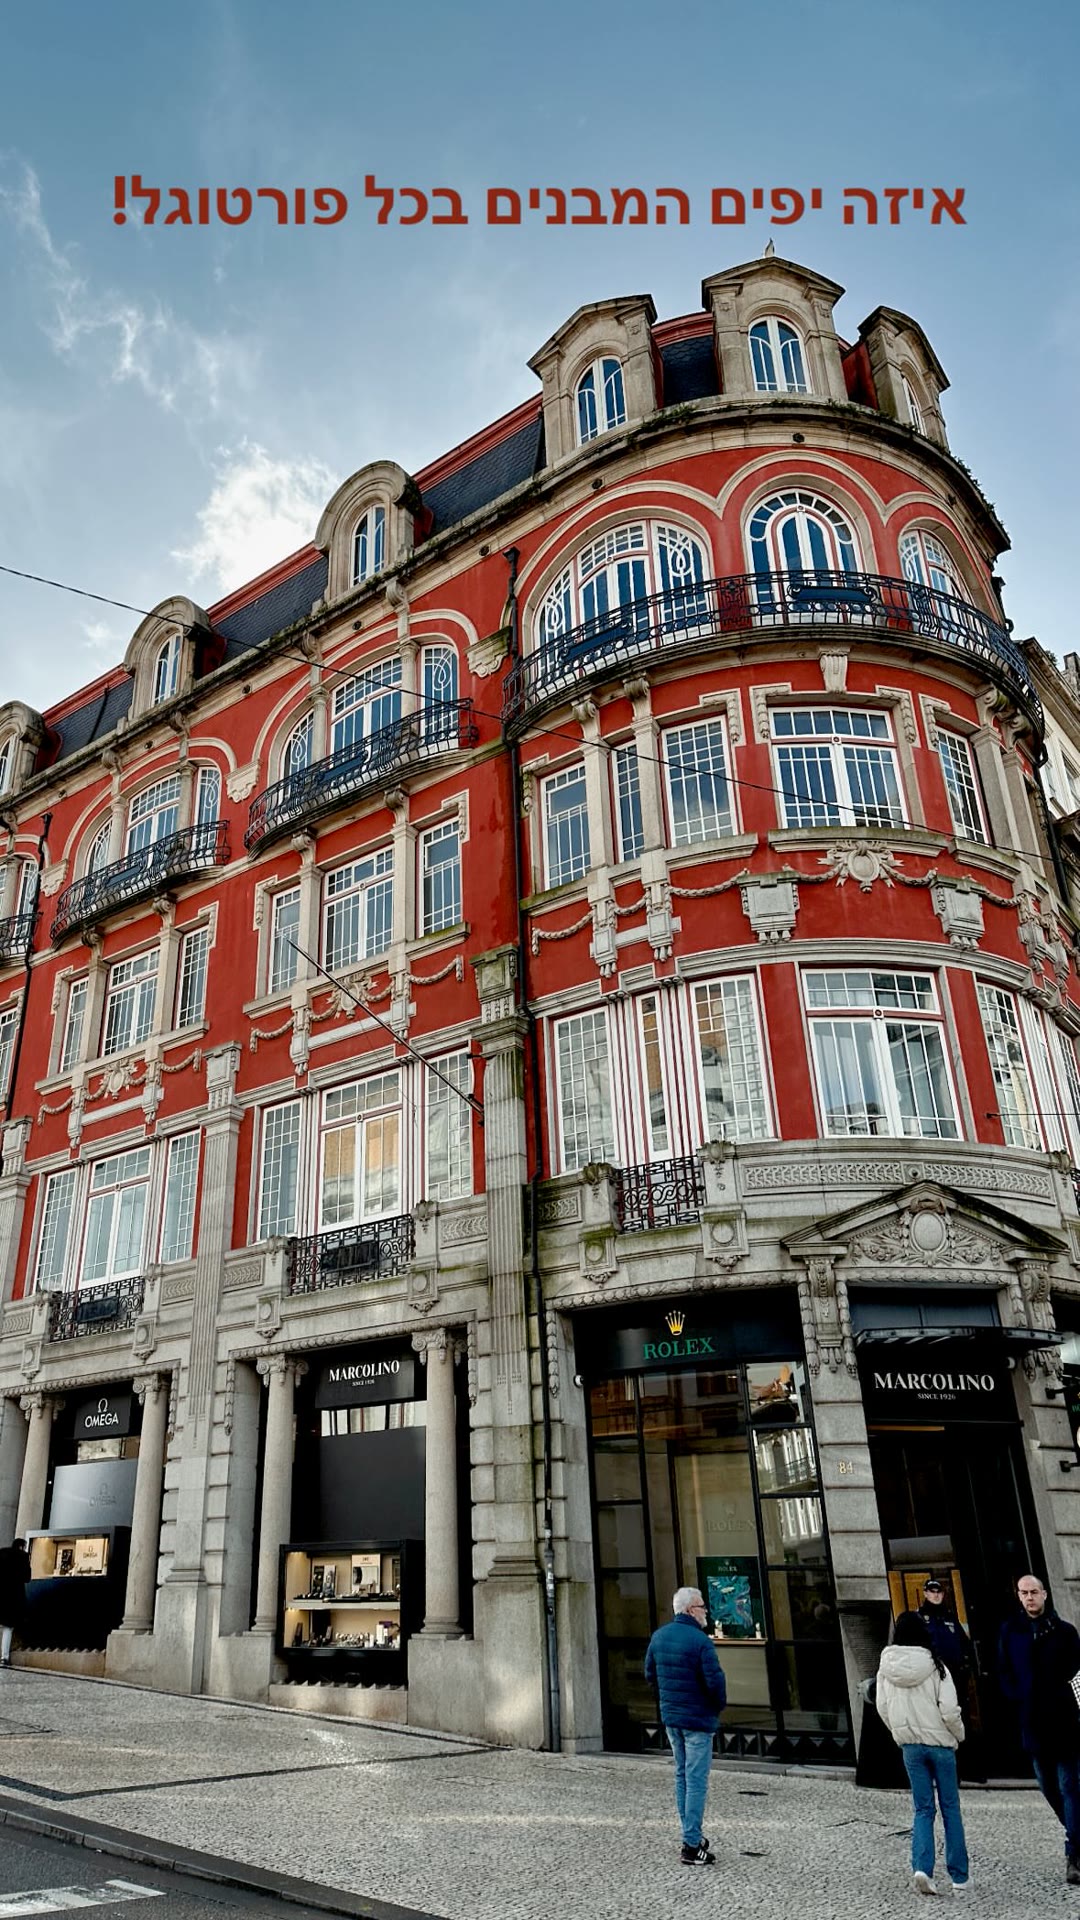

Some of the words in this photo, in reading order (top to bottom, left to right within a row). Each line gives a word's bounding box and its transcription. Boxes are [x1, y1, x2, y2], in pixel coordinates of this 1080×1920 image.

[643, 1336, 716, 1360] ROLEX
[328, 1359, 401, 1382] MARCOLINO
[873, 1372, 995, 1391] MARCOLINO
[917, 1392, 939, 1400] SINCE
[84, 1412, 119, 1428] OMEGA
[839, 1461, 854, 1474] 84
